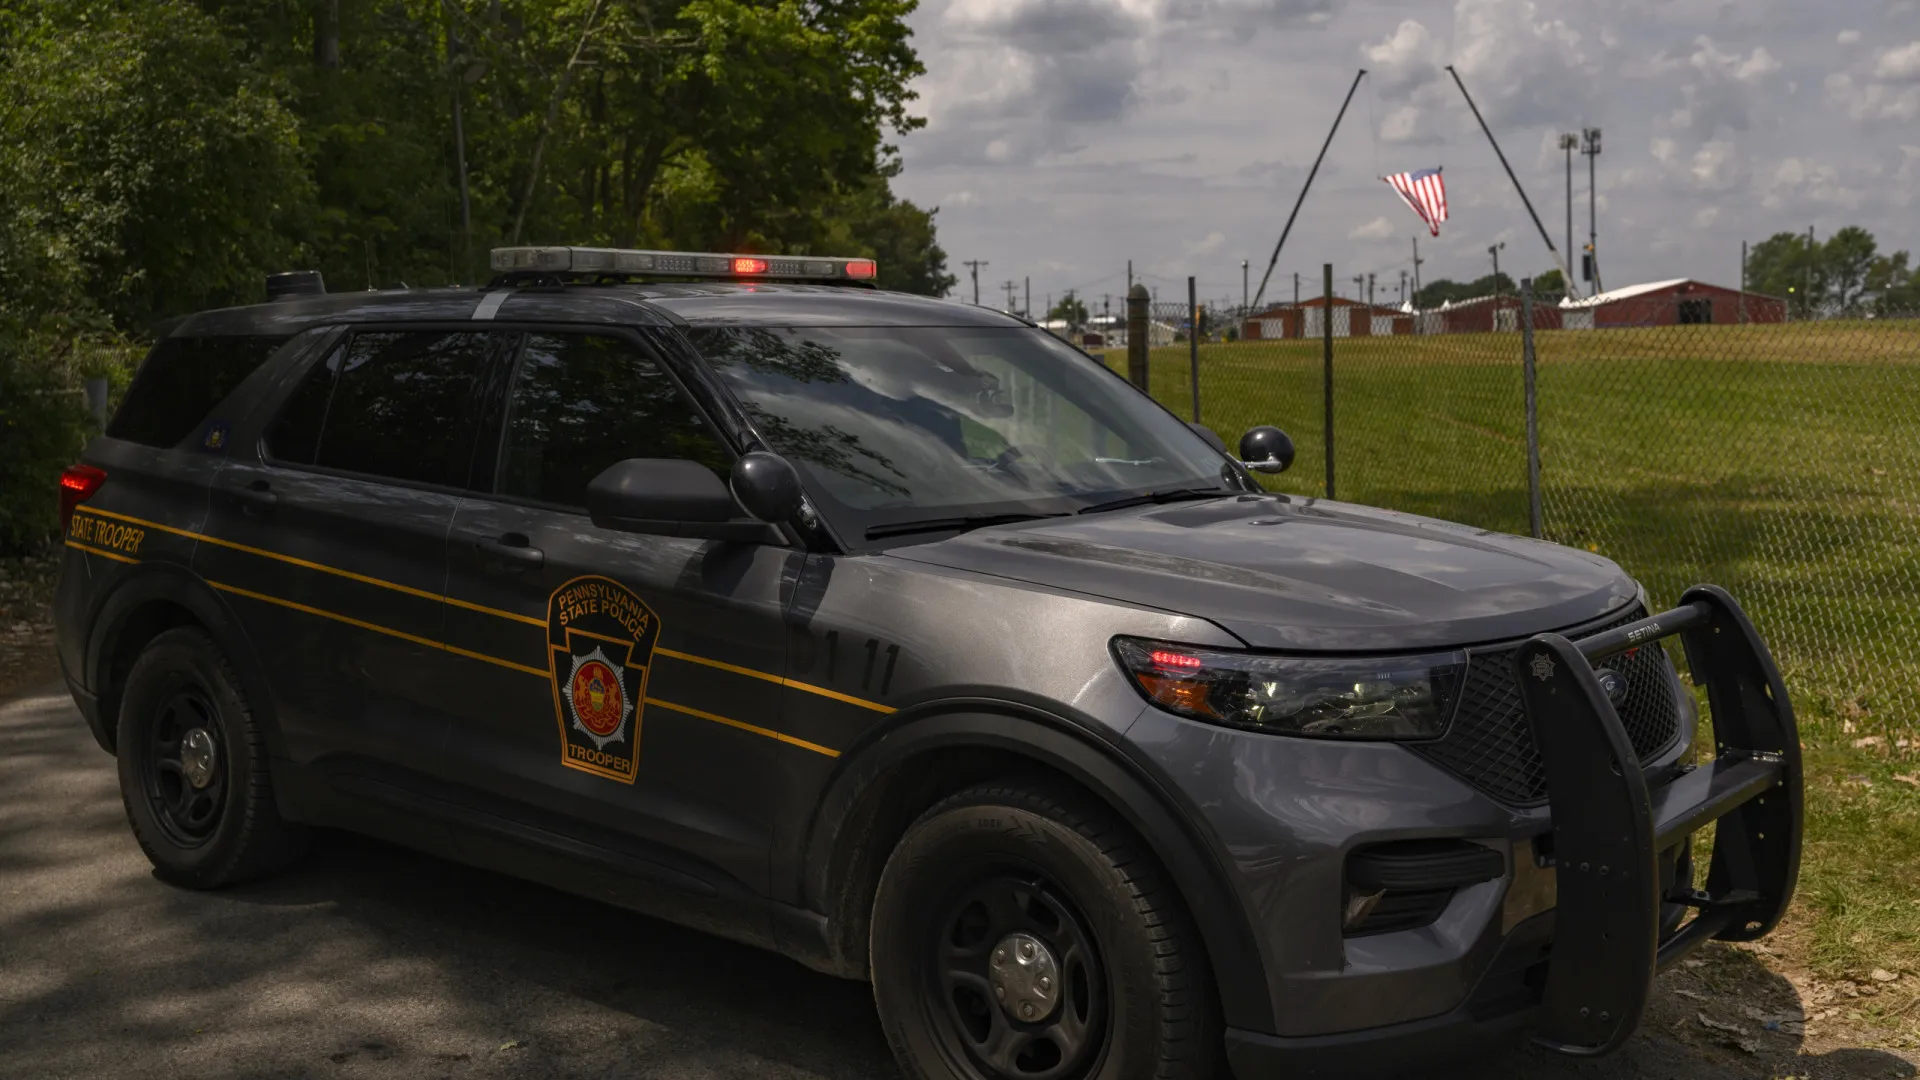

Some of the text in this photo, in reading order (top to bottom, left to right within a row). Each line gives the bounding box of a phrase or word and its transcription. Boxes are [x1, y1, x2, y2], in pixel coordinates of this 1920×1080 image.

[71, 515, 145, 553] STATE TROOPER
[559, 583, 649, 629] PENNSYLVANIA
[560, 599, 645, 641] STATE POLICE
[1628, 623, 1661, 642] SETINA
[569, 743, 631, 773] TROOPER
